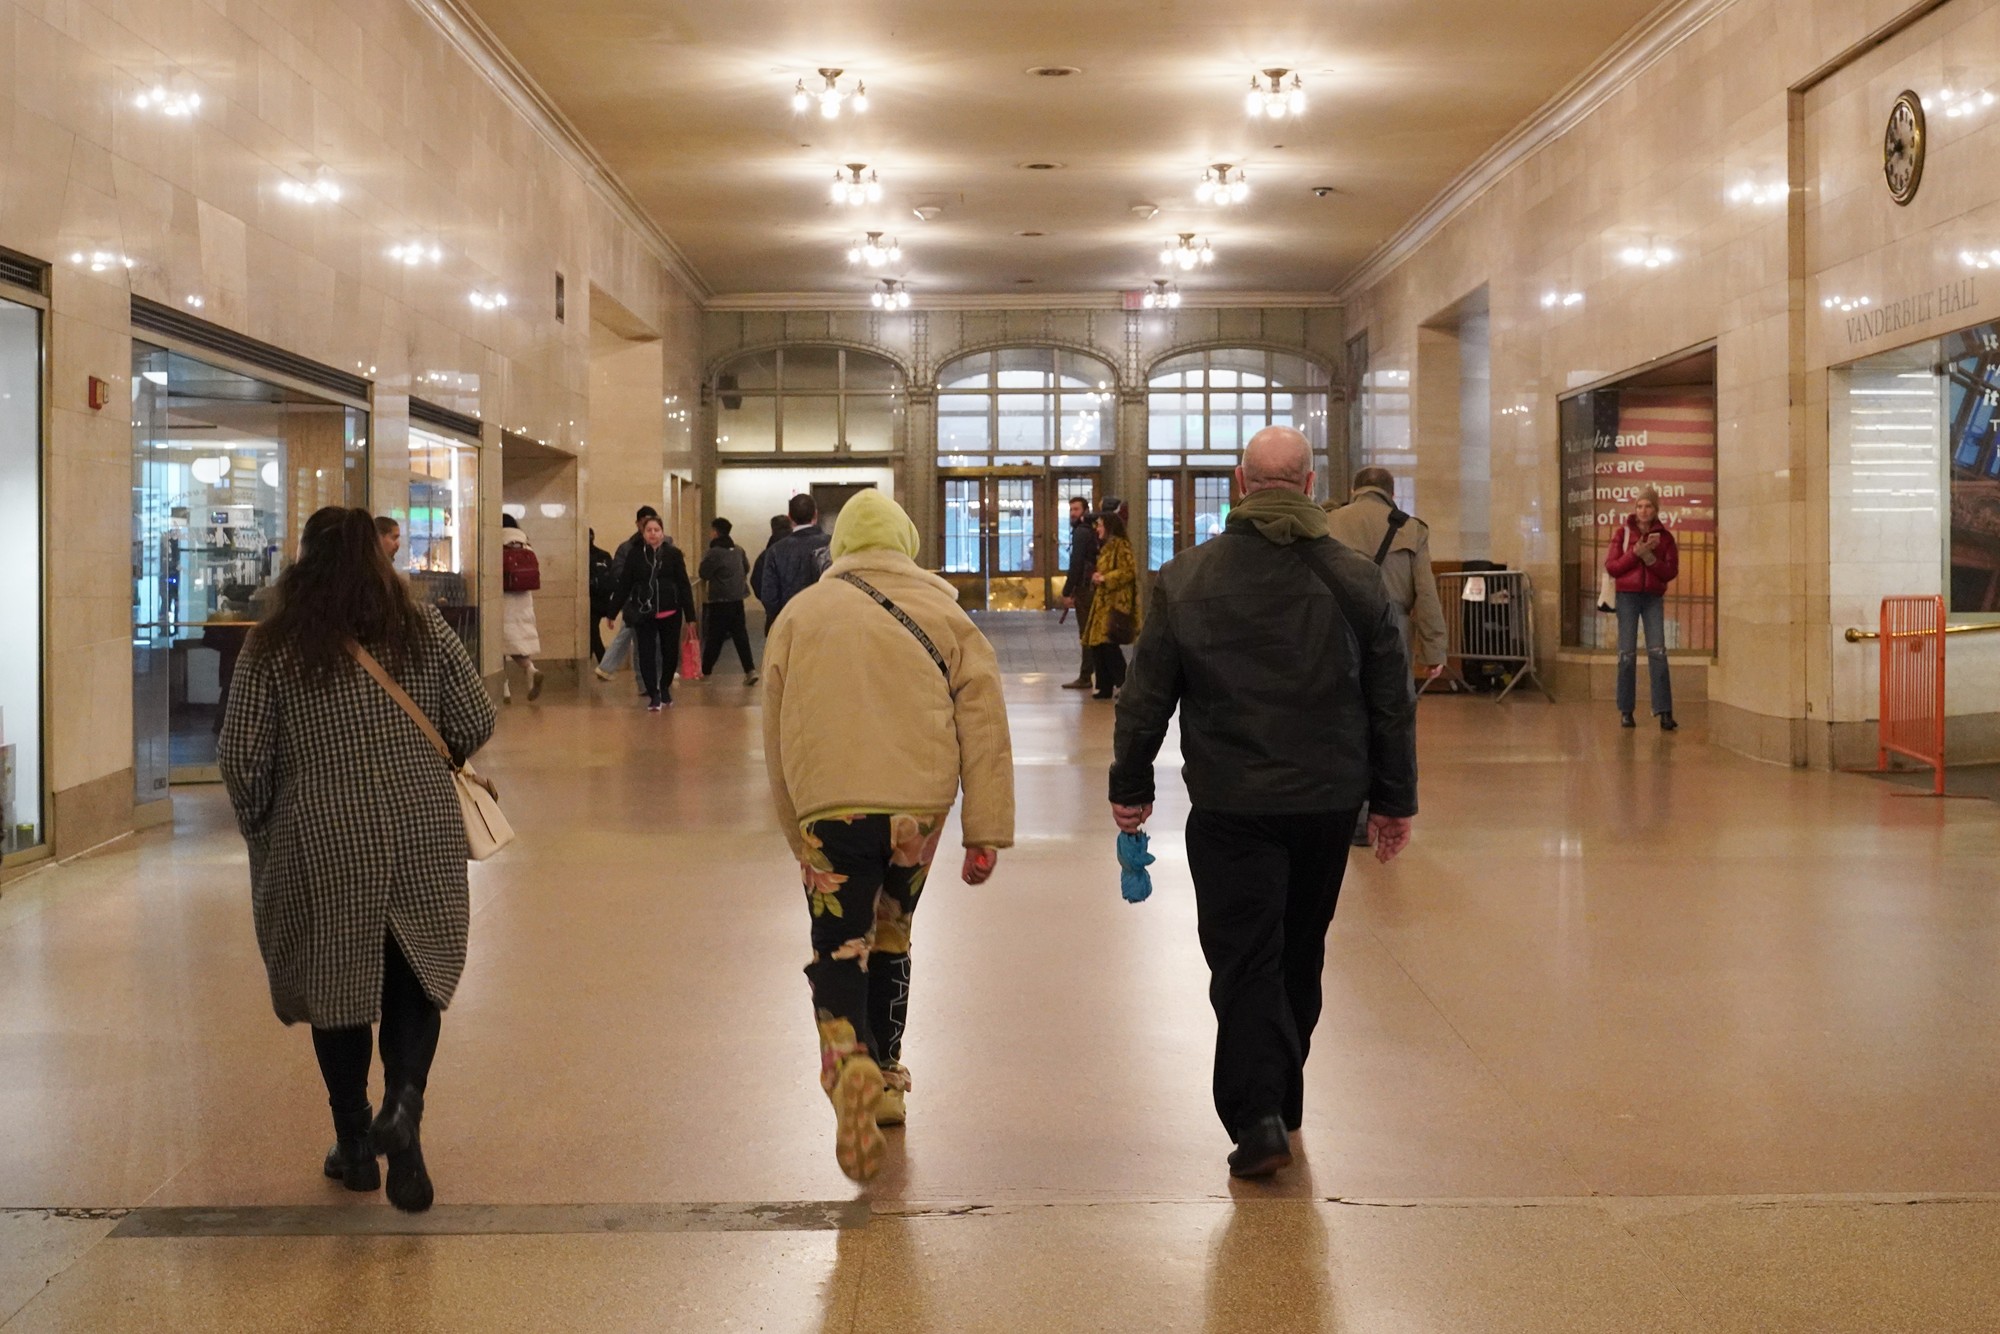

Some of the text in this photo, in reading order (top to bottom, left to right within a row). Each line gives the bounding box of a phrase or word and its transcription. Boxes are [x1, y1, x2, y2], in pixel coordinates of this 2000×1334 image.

[1846, 276, 1979, 344] VANDERBILT HALL
[1615, 430, 1648, 447] and
[1616, 460, 1645, 473] are
[1596, 485, 1640, 499] more
[1597, 508, 1616, 525] of
[888, 604, 942, 665] SUPREME
